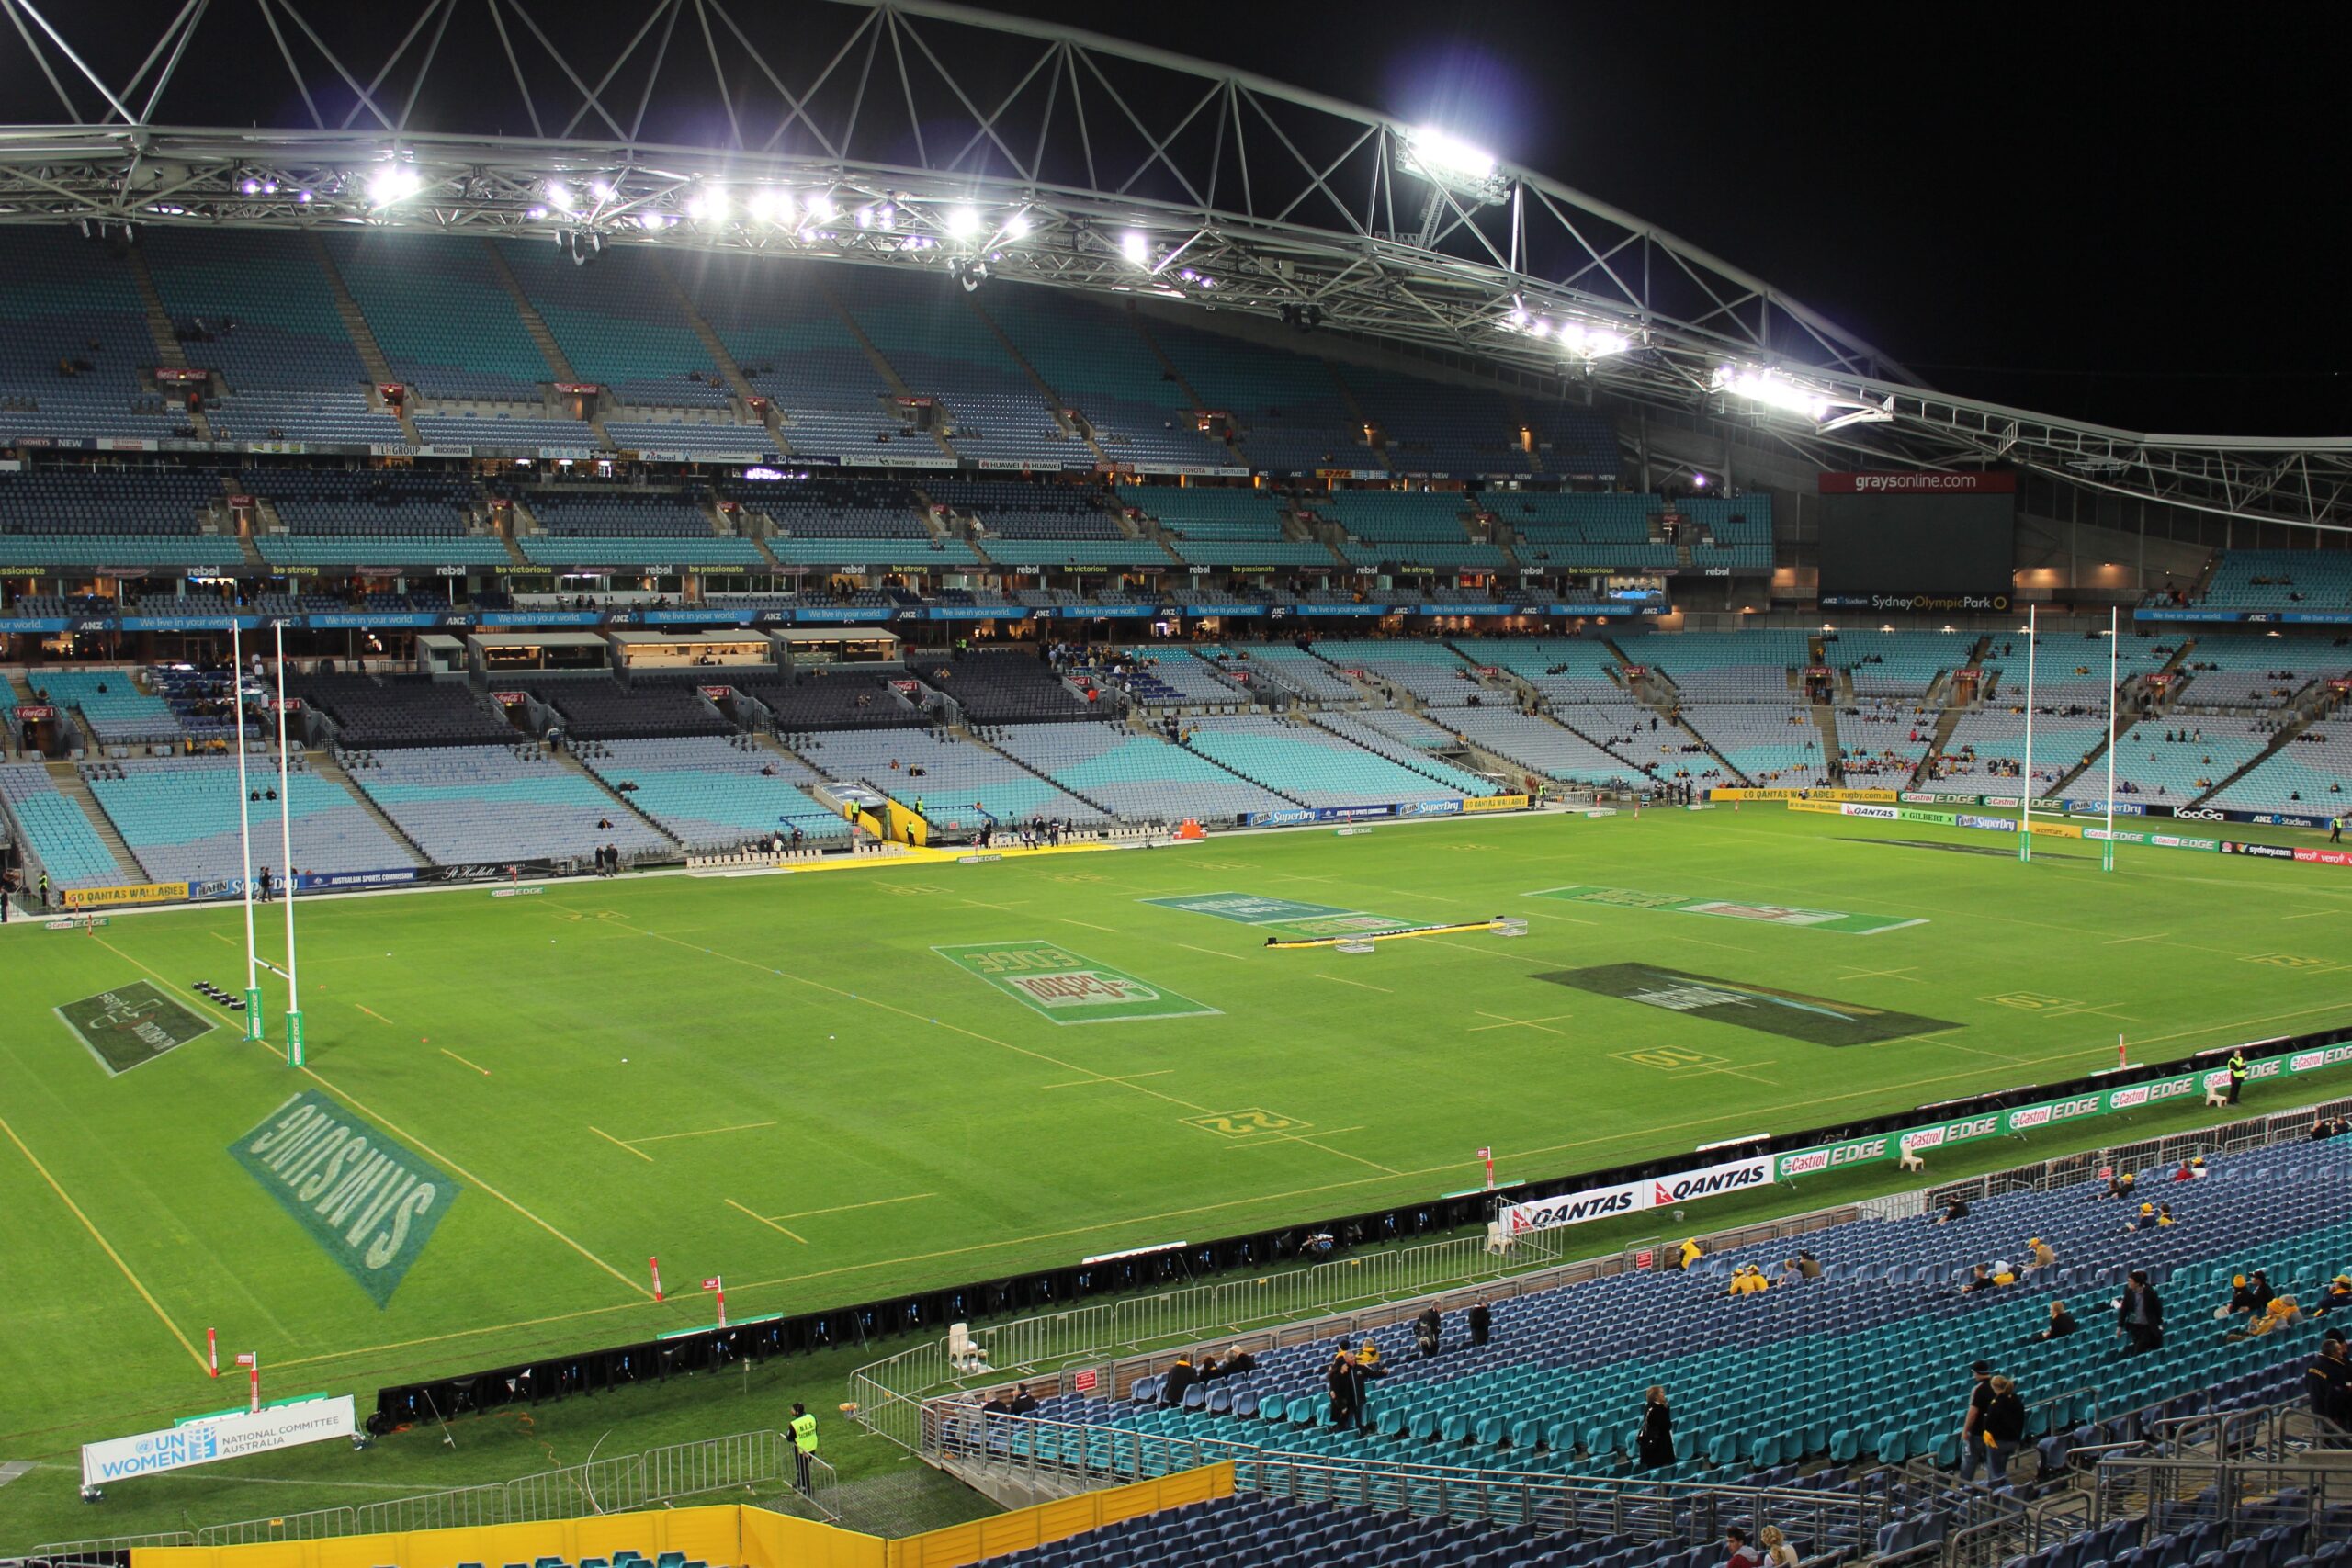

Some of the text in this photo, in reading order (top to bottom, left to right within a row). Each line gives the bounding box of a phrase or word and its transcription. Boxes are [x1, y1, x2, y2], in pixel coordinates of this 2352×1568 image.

[57, 439, 83, 447] NEW
[1856, 474, 1976, 491] graysonline.com
[0, 566, 45, 575] ssionate
[287, 567, 318, 576] strong
[701, 566, 744, 575] passionate
[904, 566, 928, 574] strong
[1242, 566, 1275, 574] passionate
[1872, 595, 1990, 610] SydneyOlympicPark
[325, 615, 339, 625] We
[341, 615, 356, 624] live
[368, 617, 386, 626] your
[498, 615, 511, 623] We
[537, 615, 555, 624] your
[610, 615, 628, 623] ANZ
[658, 612, 671, 620] We
[13, 619, 42, 628] world.
[80, 621, 103, 630] ANZ
[140, 617, 154, 626] We
[157, 617, 173, 626] live
[175, 618, 183, 626] in
[186, 620, 206, 628] your
[1757, 791, 1787, 799] QANTAS
[1841, 791, 1893, 801] rugby.com.au
[1908, 793, 1976, 805] Castrol EDGE
[1420, 801, 1459, 814] SuperDry
[1992, 798, 2018, 807] Castrol
[2070, 801, 2141, 815] HAHN SuerDry
[1272, 809, 1316, 825] SuperDry
[1854, 807, 1894, 818] QANTAS
[1909, 812, 1942, 822] GILBERT
[2173, 807, 2224, 821] KooGa
[1977, 818, 2014, 831] SuperDry
[2252, 815, 2312, 827] ANZ Stadium
[2113, 832, 2144, 841] EDGE
[2180, 839, 2215, 849] EDGE
[2249, 845, 2291, 857] sydney.com
[2294, 851, 2312, 861] vero
[2321, 853, 2339, 863] vero
[332, 873, 413, 885] AUSTRALIAN SPORTS COMMISSION
[200, 880, 228, 893] HAHN
[87, 889, 127, 902] QANTAS
[130, 886, 185, 898] WALLABIES
[74, 919, 107, 927] EDGE
[963, 948, 1083, 974] EDGE
[2297, 1044, 2352, 1068] Castrol EDG
[2245, 1060, 2282, 1080] EDGE
[2119, 1077, 2195, 1106] Castrol EDGE
[2018, 1096, 2100, 1126] Castrol EDGE
[1195, 1112, 1290, 1133] 22
[1910, 1116, 1999, 1148] Castrol EDGE
[1792, 1138, 1887, 1173] Castrol EDGE
[250, 1104, 436, 1271] SAMSUNG
[1673, 1165, 1765, 1200] QANTAS
[1532, 1191, 1633, 1228] QANTAS
[222, 1416, 340, 1446] NATIONAL COMMITTEE
[156, 1433, 185, 1451] UN
[222, 1436, 285, 1455] AUSTRALIA
[101, 1449, 186, 1479] WOMEN
